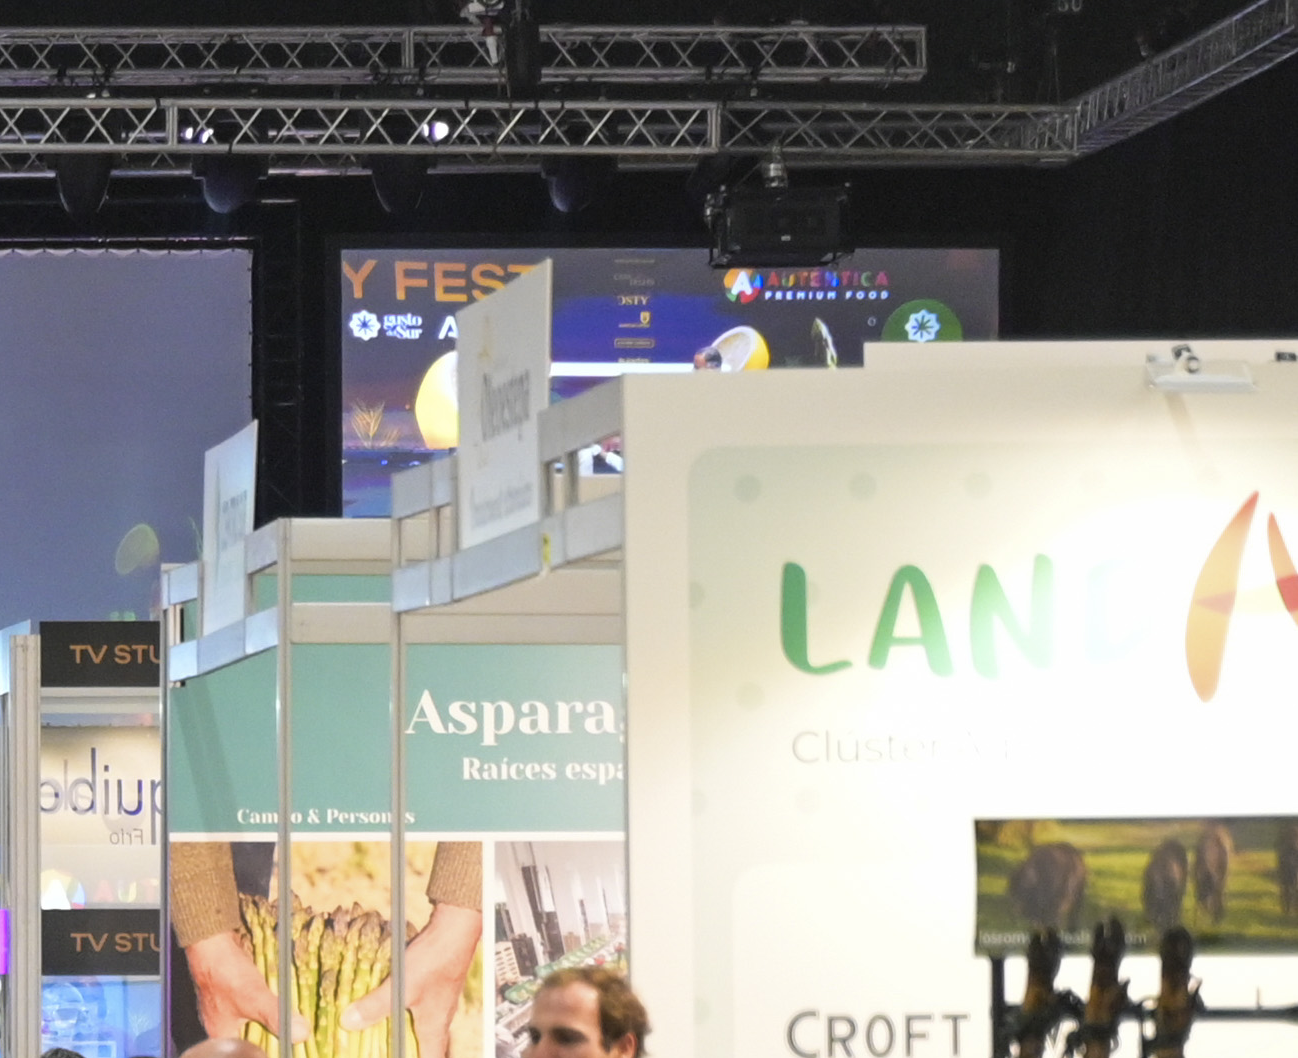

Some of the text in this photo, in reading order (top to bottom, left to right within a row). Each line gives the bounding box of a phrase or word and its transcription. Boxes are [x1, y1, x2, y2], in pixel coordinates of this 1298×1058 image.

[343, 259, 379, 299] Y
[764, 290, 890, 300] PREMIUM FOOD
[383, 313, 423, 328] gusto
[395, 325, 423, 340] Sur
[69, 644, 108, 665] TV
[404, 689, 624, 746] Aspara
[461, 756, 557, 781] Raíces
[236, 808, 416, 824] Camo & Persons
[70, 932, 109, 953] TV
